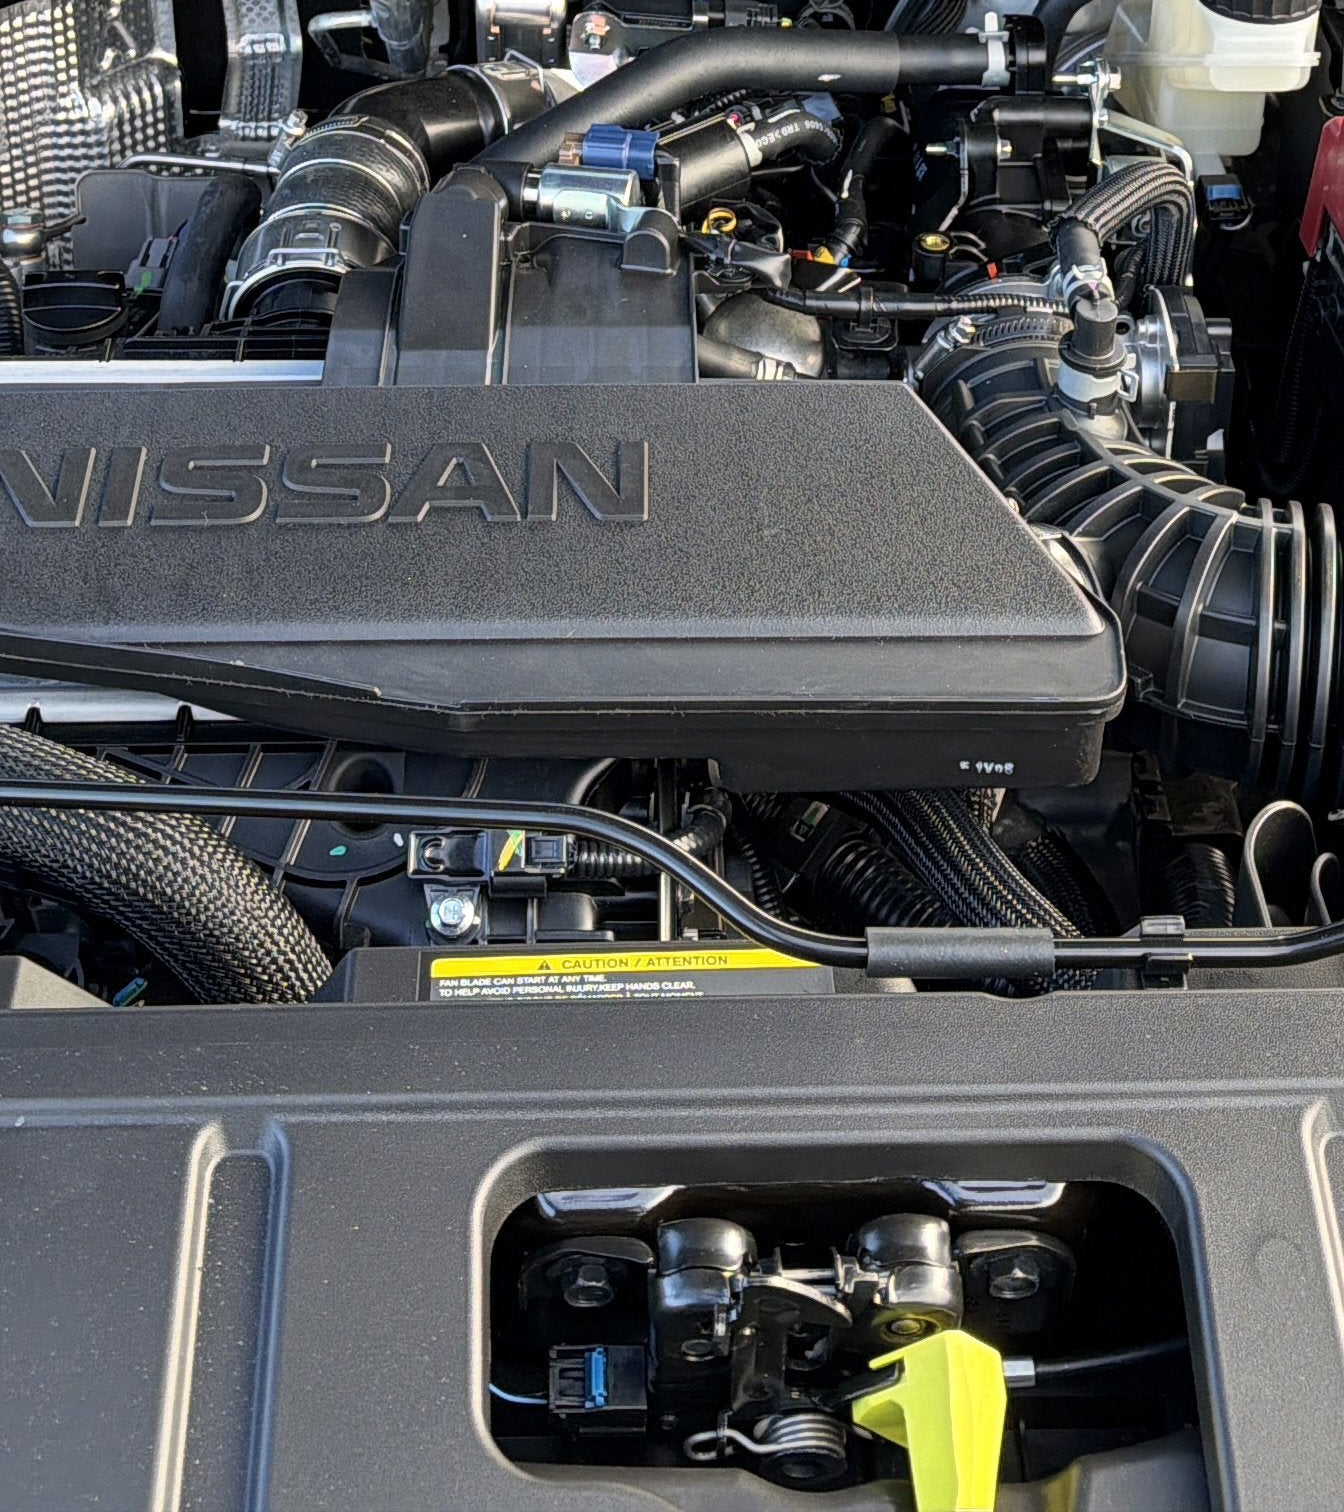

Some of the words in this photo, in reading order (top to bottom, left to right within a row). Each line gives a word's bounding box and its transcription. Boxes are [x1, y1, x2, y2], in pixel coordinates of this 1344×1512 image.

[561, 958, 629, 970] CAUTION
[646, 955, 729, 968] ATTENTION
[439, 979, 458, 987] FAN
[460, 978, 492, 987] BLADE
[493, 977, 515, 986] CAN
[517, 976, 546, 985] START
[547, 975, 560, 984] AT
[561, 975, 582, 983] ANY
[439, 988, 453, 997] TO
[454, 987, 481, 997] HELP
[481, 986, 512, 996] AVOID
[512, 985, 564, 995] PERSONAL
[625, 982, 661, 991] HANDS
